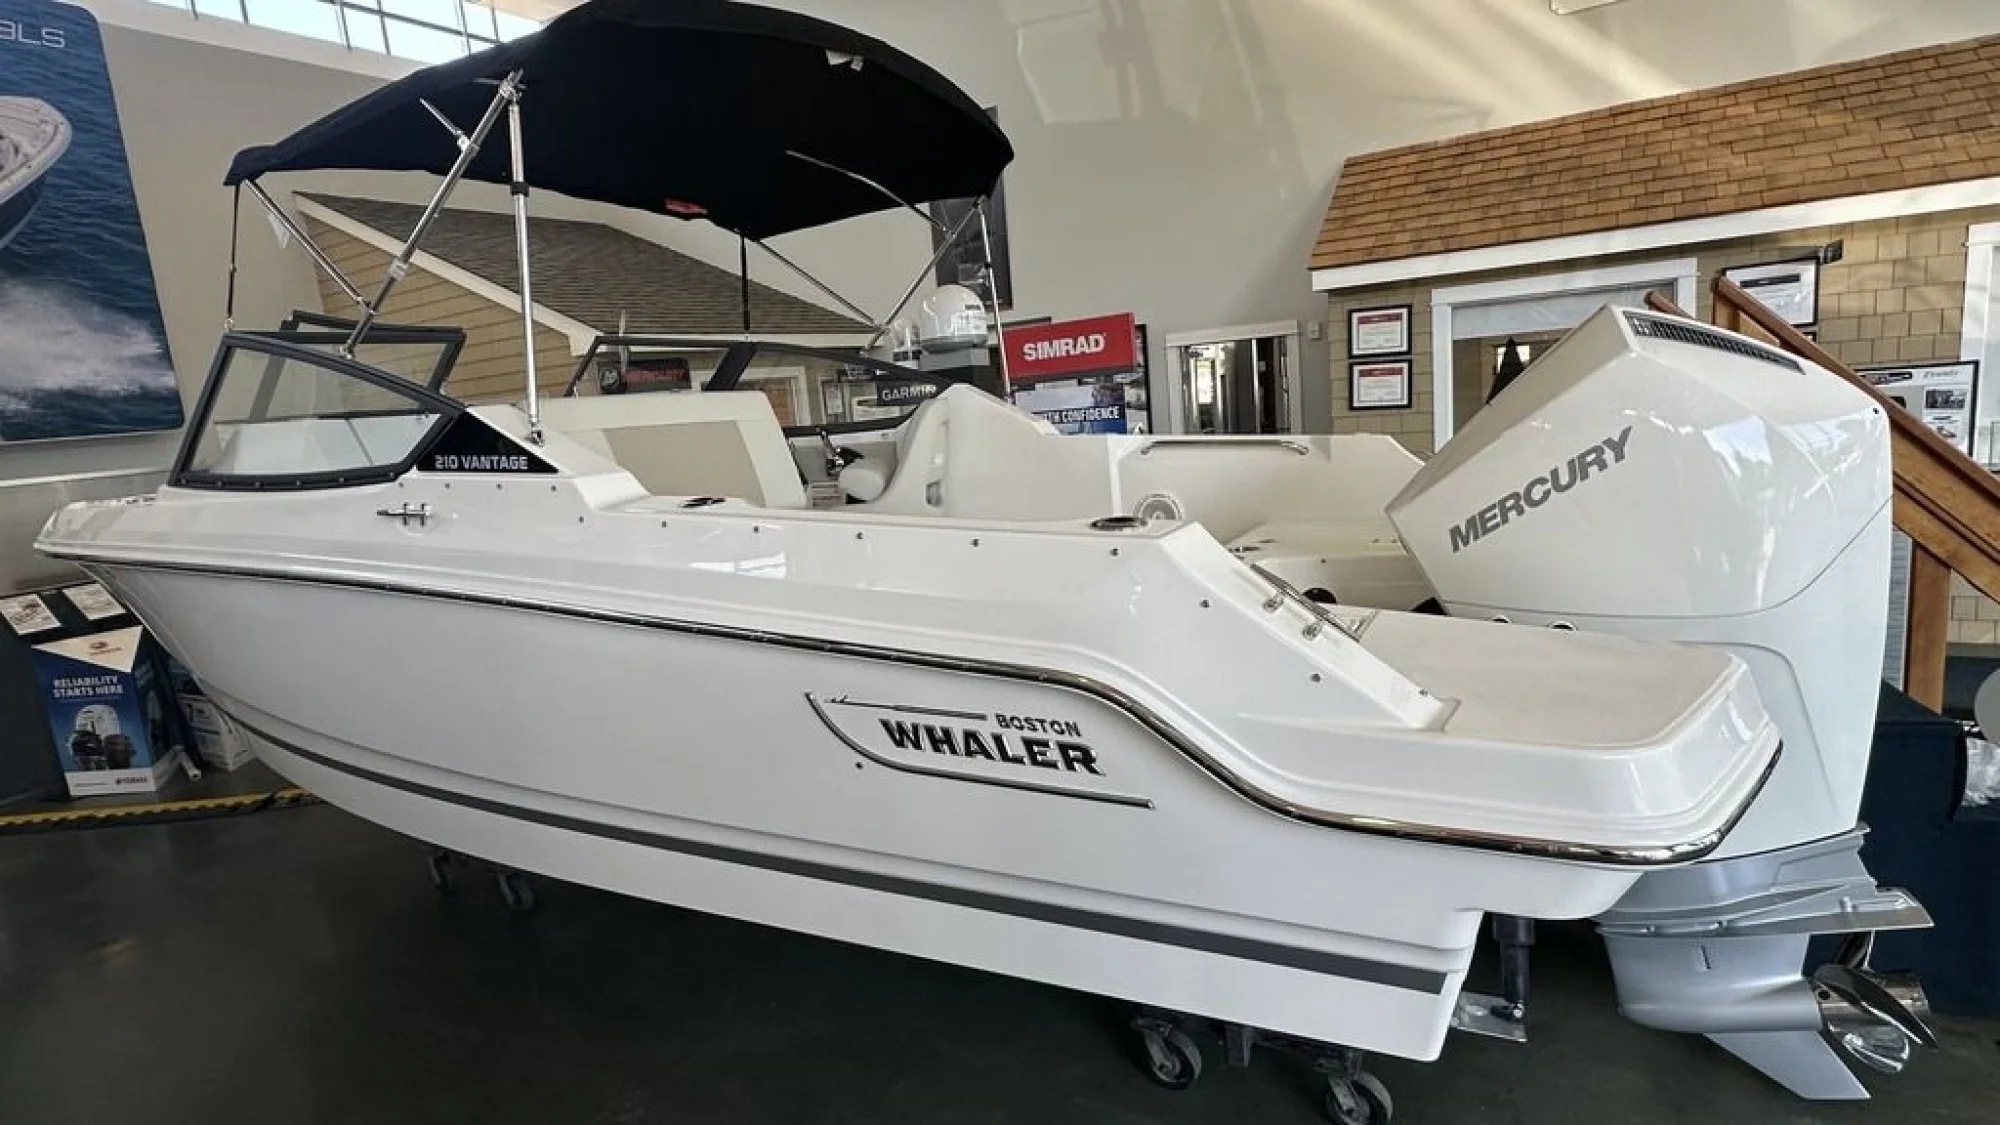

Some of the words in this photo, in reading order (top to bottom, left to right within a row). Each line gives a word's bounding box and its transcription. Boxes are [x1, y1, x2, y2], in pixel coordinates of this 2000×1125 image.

[1022, 333, 1105, 362] SIMRAD
[1062, 404, 1120, 423] CONFIDENCE
[434, 454, 459, 470] 210
[461, 454, 528, 470] VANTAGE
[1448, 425, 1634, 554] MERCURY
[53, 675, 119, 690] RELIABILITY
[53, 686, 95, 698] STARTS
[96, 683, 124, 696] HERE
[995, 712, 1083, 738] BOSTON
[878, 717, 1107, 778] WHALER
